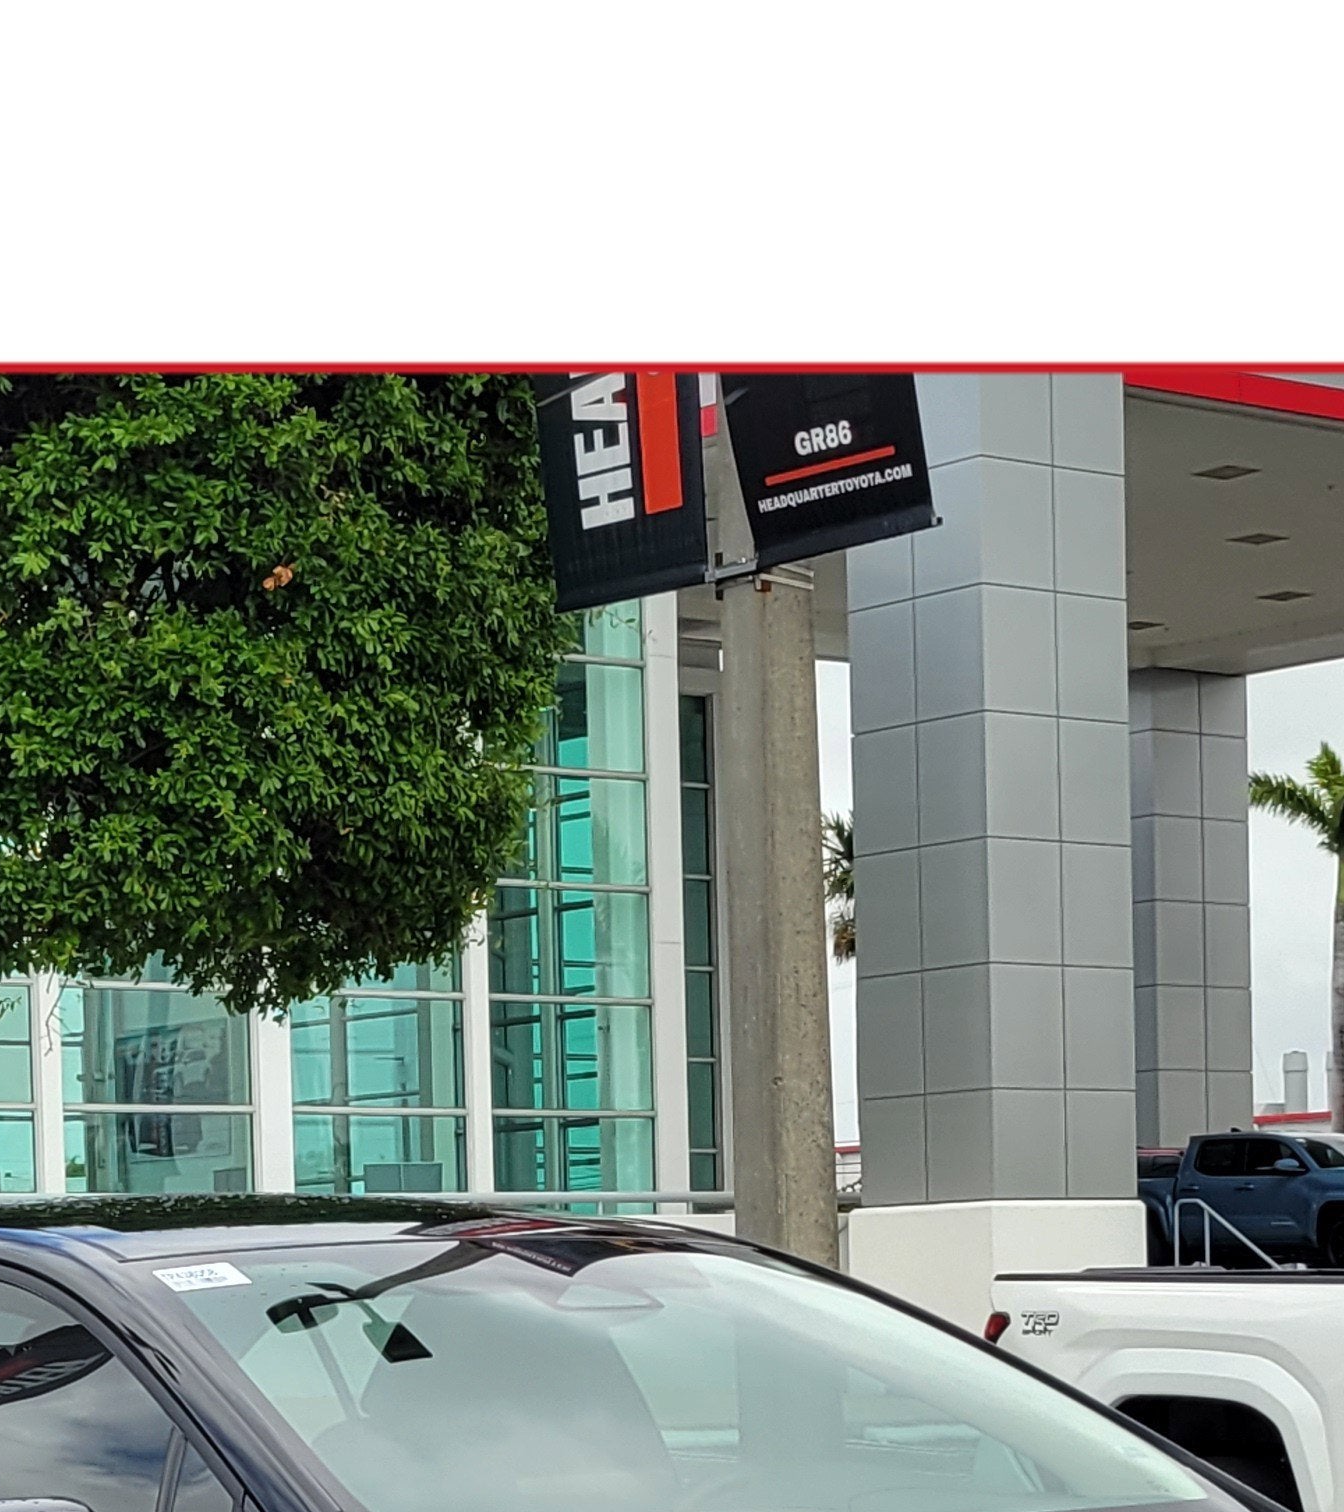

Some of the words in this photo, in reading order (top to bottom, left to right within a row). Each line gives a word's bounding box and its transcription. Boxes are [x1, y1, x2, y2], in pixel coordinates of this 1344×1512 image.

[569, 373, 636, 530] HEA
[794, 420, 852, 456] GR86
[757, 463, 913, 514] HEADQUARTERTOYOTA.COM
